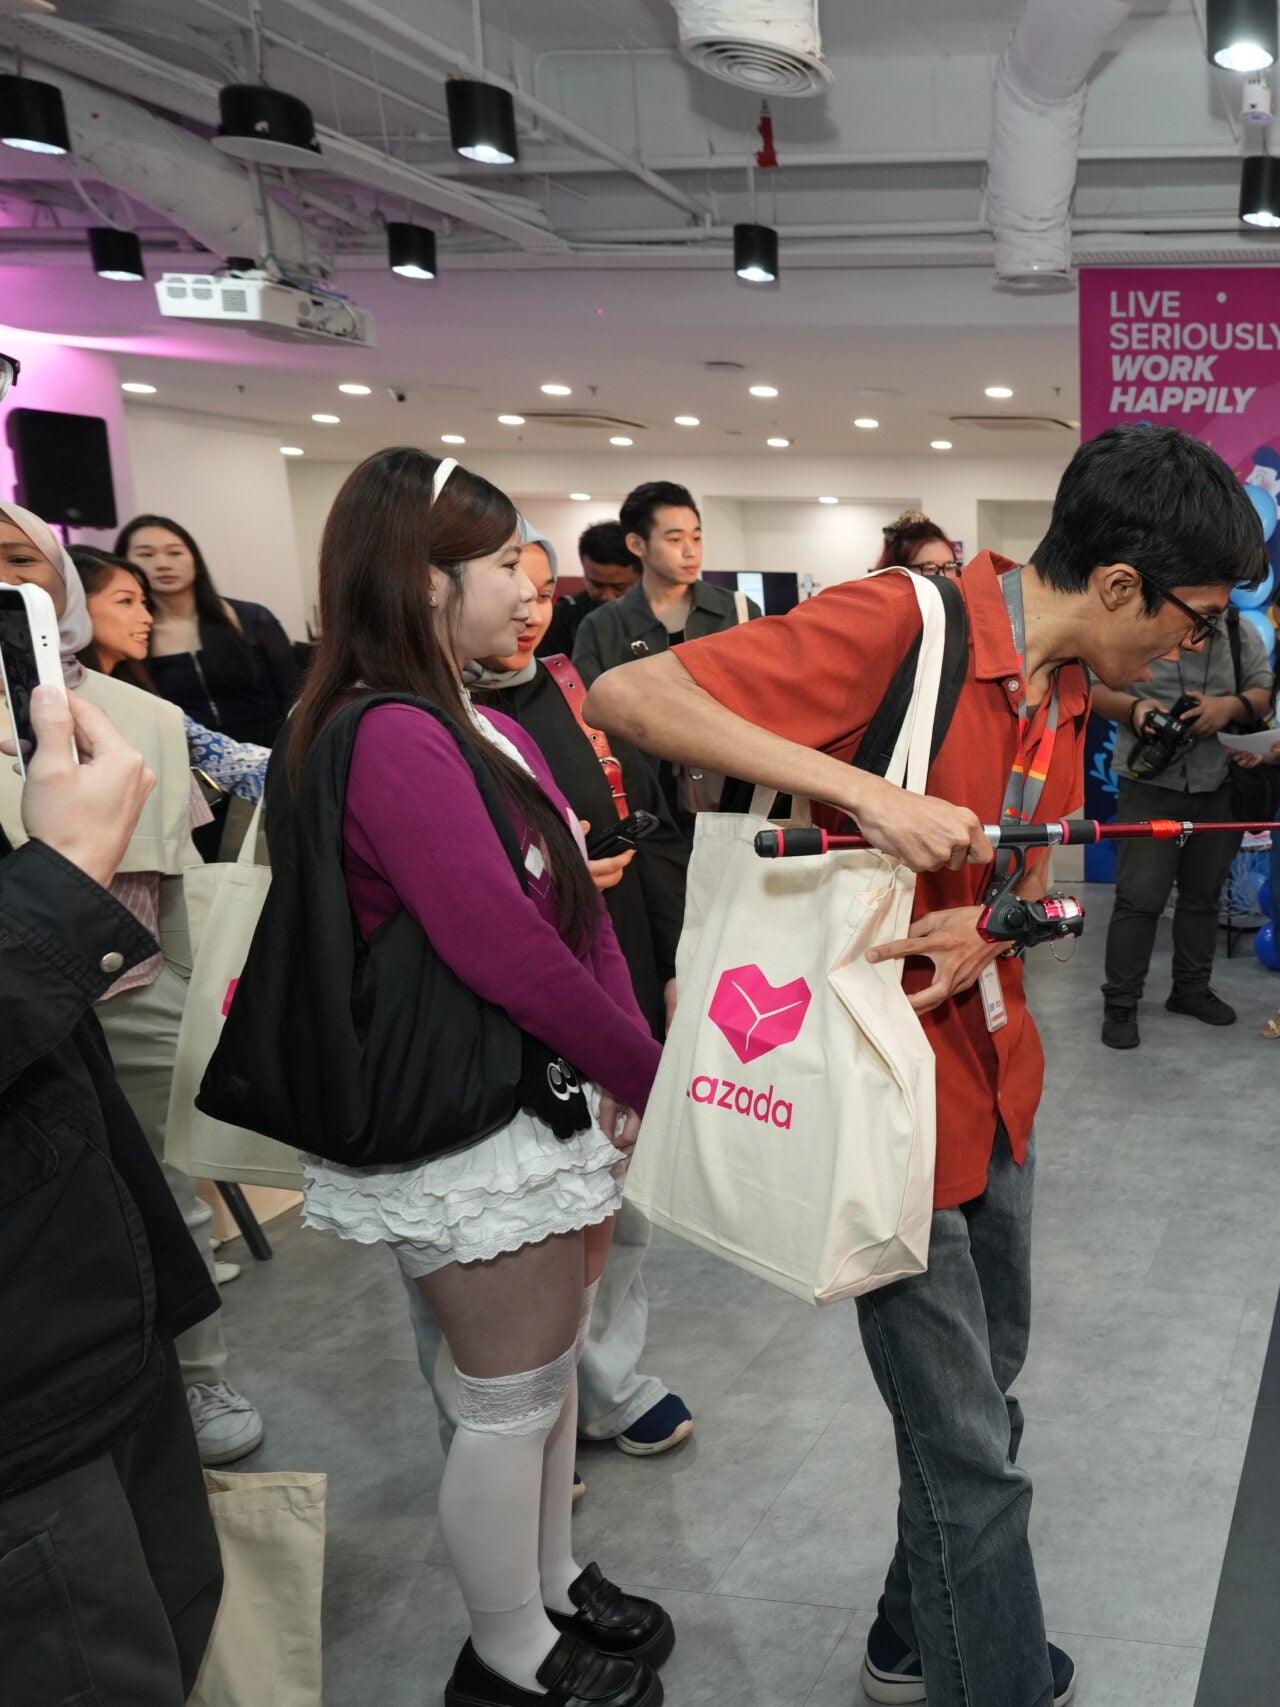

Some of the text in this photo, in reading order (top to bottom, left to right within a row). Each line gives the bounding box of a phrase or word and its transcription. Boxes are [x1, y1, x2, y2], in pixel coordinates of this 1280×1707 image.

[1110, 291, 1180, 318] LIVE
[1111, 354, 1219, 382] WORK
[1108, 386, 1257, 414] HAPPILY
[686, 1075, 794, 1130] azada
